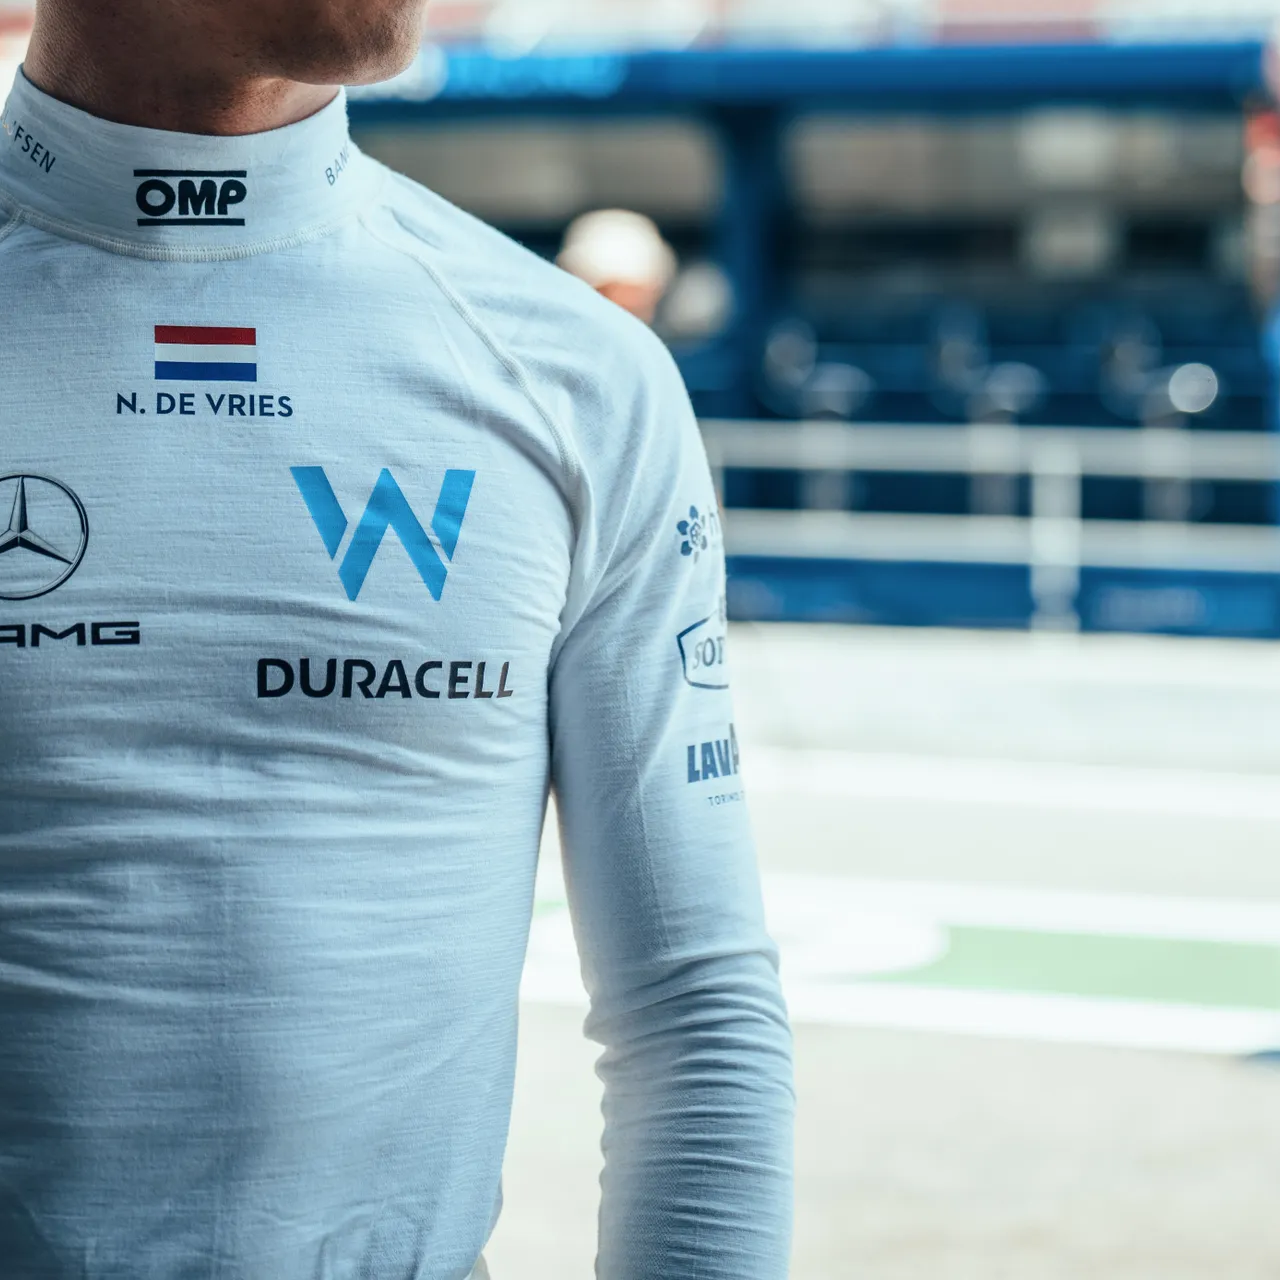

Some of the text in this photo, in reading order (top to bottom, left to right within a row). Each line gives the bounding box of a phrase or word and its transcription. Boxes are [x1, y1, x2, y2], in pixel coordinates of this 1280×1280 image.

[135, 178, 247, 217] OMP
[116, 392, 294, 418] N. DE VRIES
[256, 658, 514, 700] DURACELL
